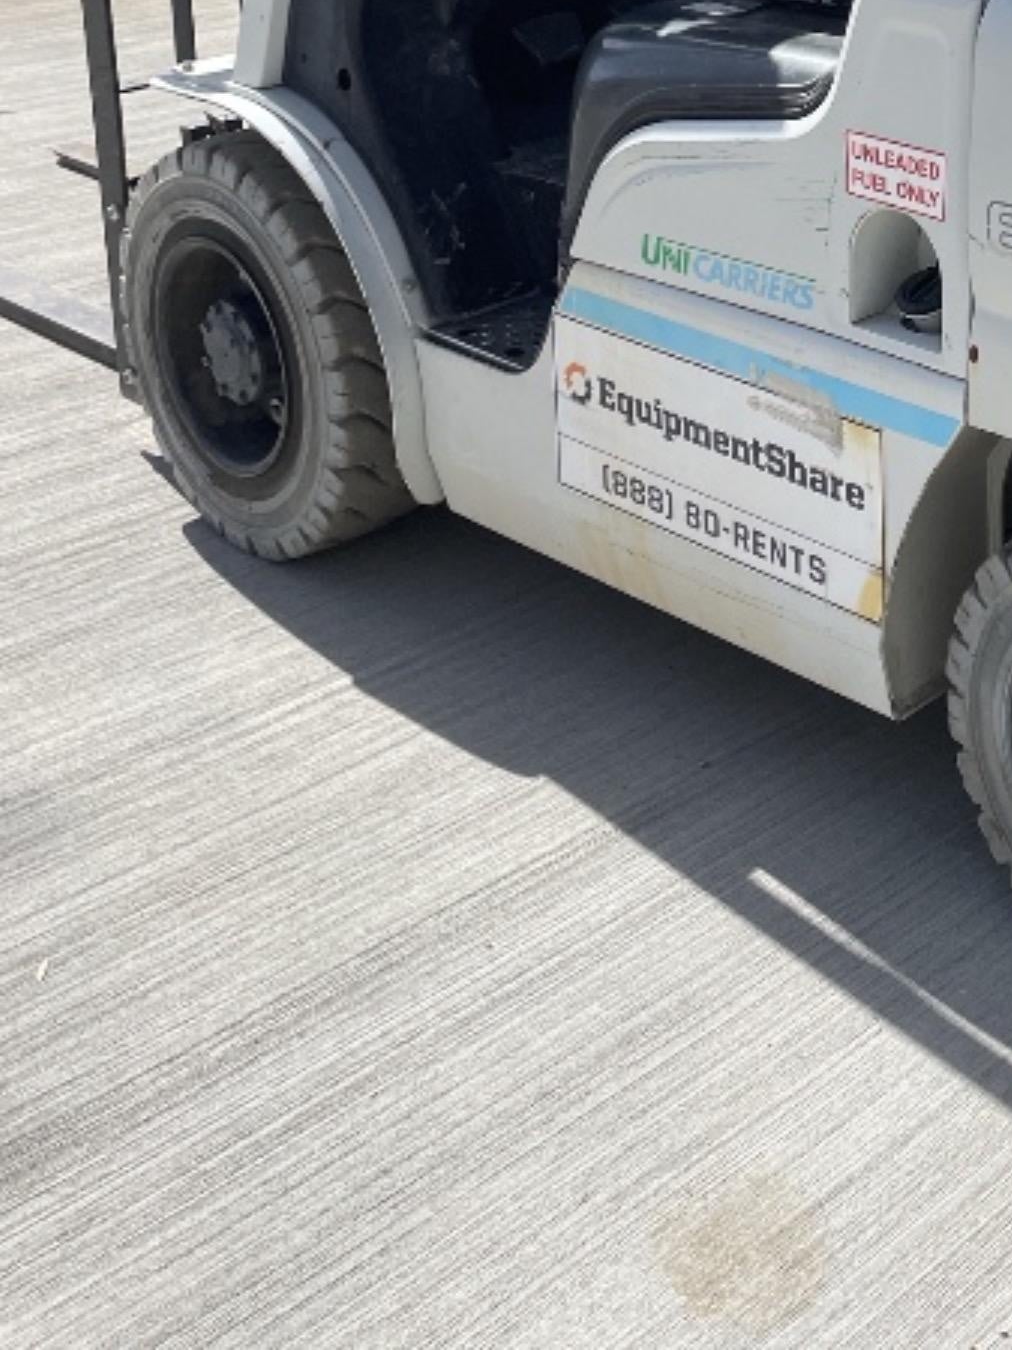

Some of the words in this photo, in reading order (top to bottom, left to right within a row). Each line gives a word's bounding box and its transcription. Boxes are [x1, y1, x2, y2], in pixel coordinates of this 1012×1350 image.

[851, 140, 940, 181] UNLEADED
[851, 167, 892, 196] FUEL
[896, 181, 940, 208] ONLY
[641, 233, 816, 310] UNICARRIERS
[597, 377, 865, 511] EquipmentShare
[601, 463, 674, 521] (888)
[685, 499, 828, 587] 80-RENTS
